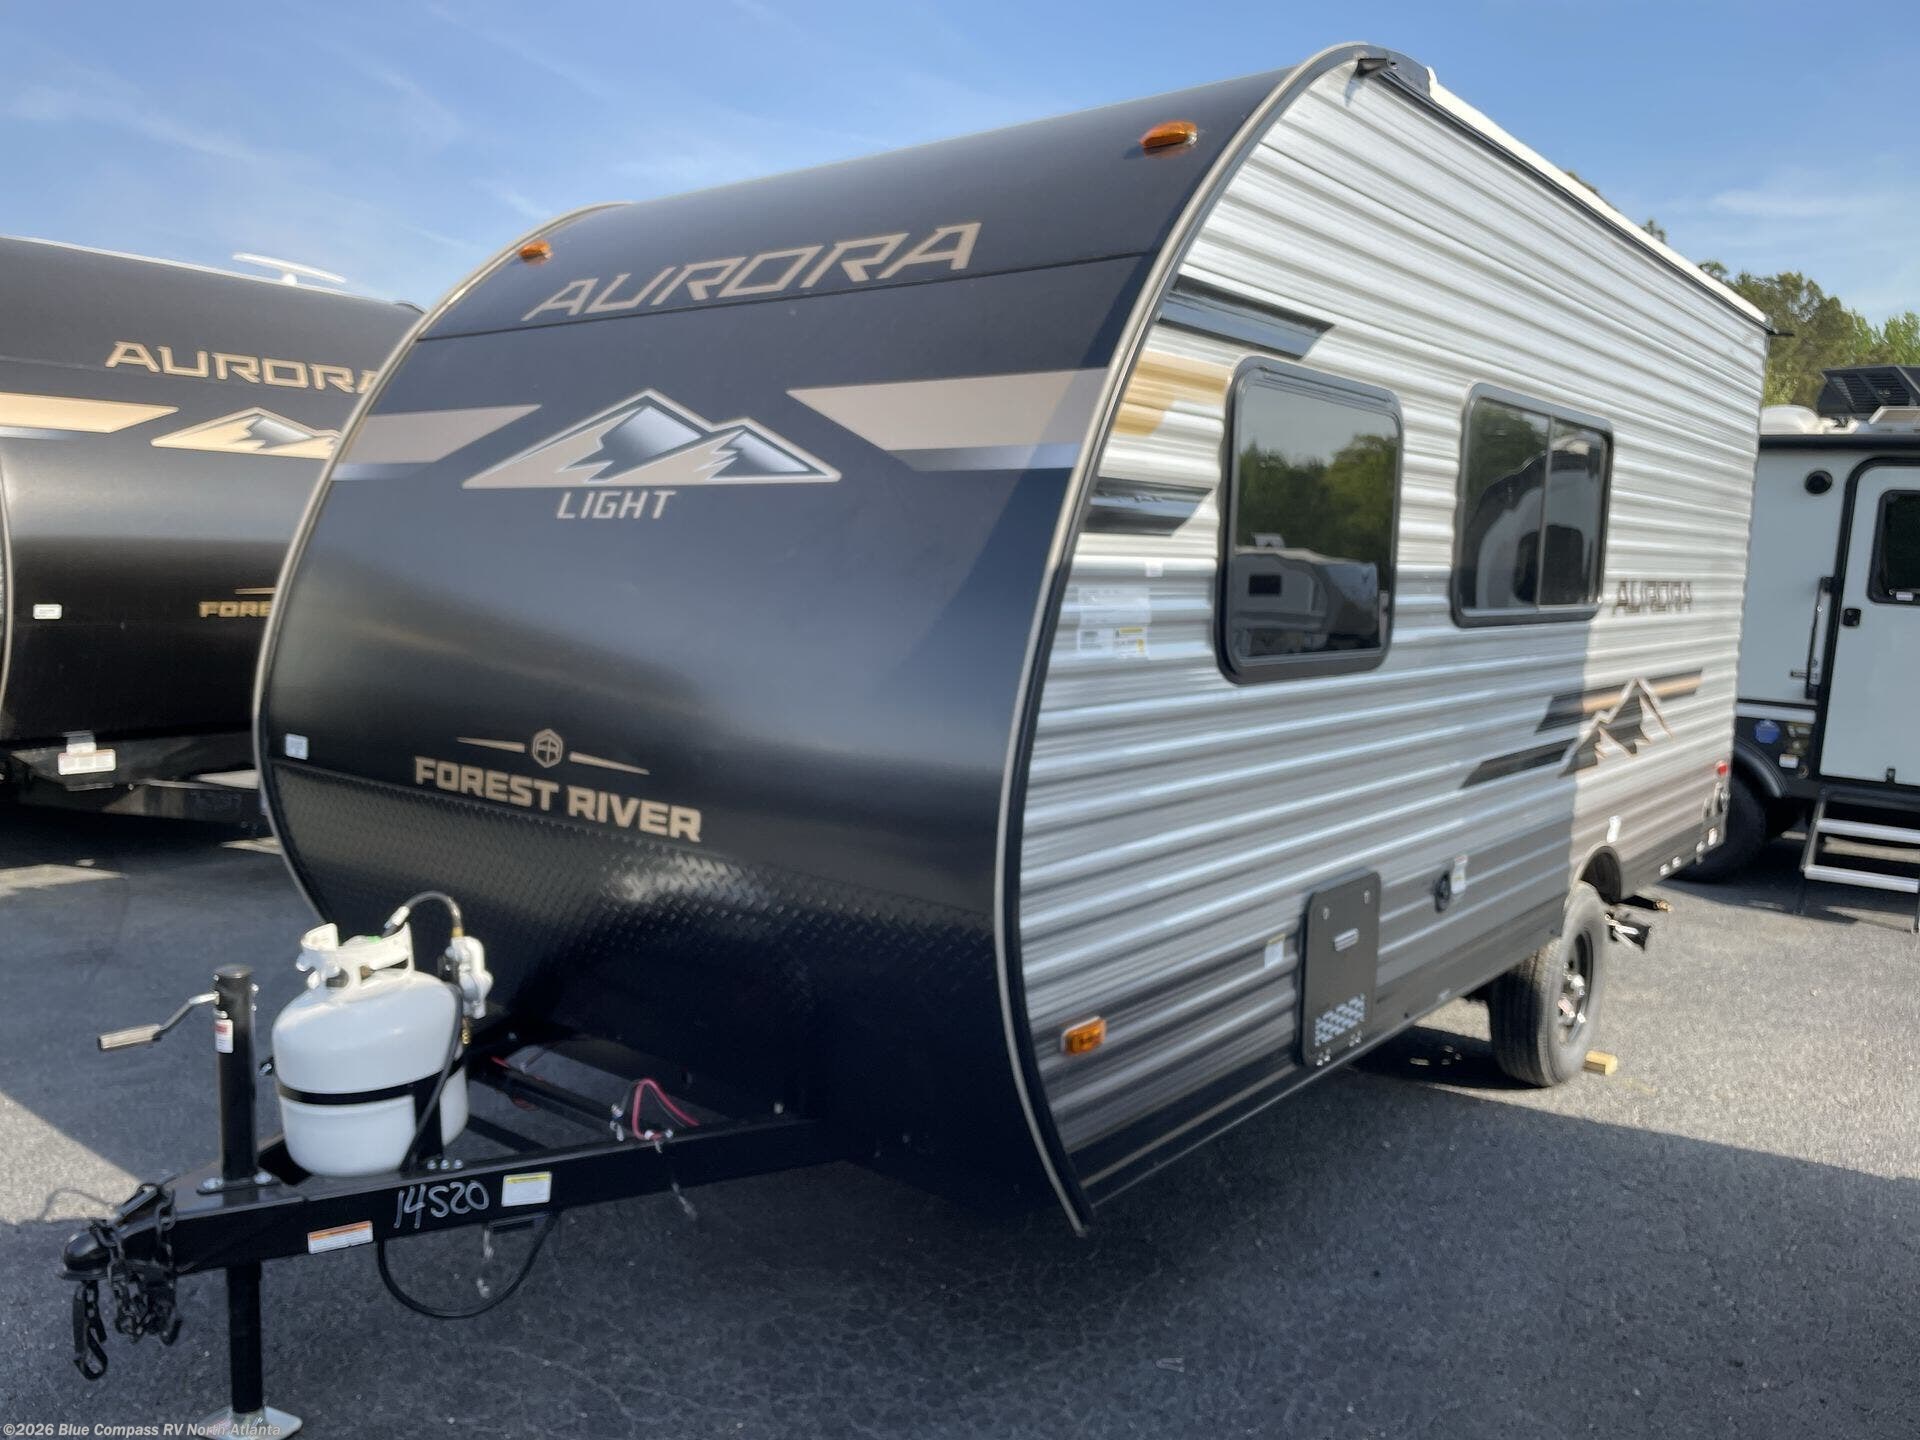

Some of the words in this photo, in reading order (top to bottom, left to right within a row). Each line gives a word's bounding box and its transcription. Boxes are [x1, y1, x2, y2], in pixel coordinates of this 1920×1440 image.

[521, 222, 982, 321] AURORA
[556, 490, 677, 519] LIGHT
[1613, 579, 1692, 615] AURORA
[414, 756, 559, 810] FOREST
[568, 785, 702, 843] RIVER
